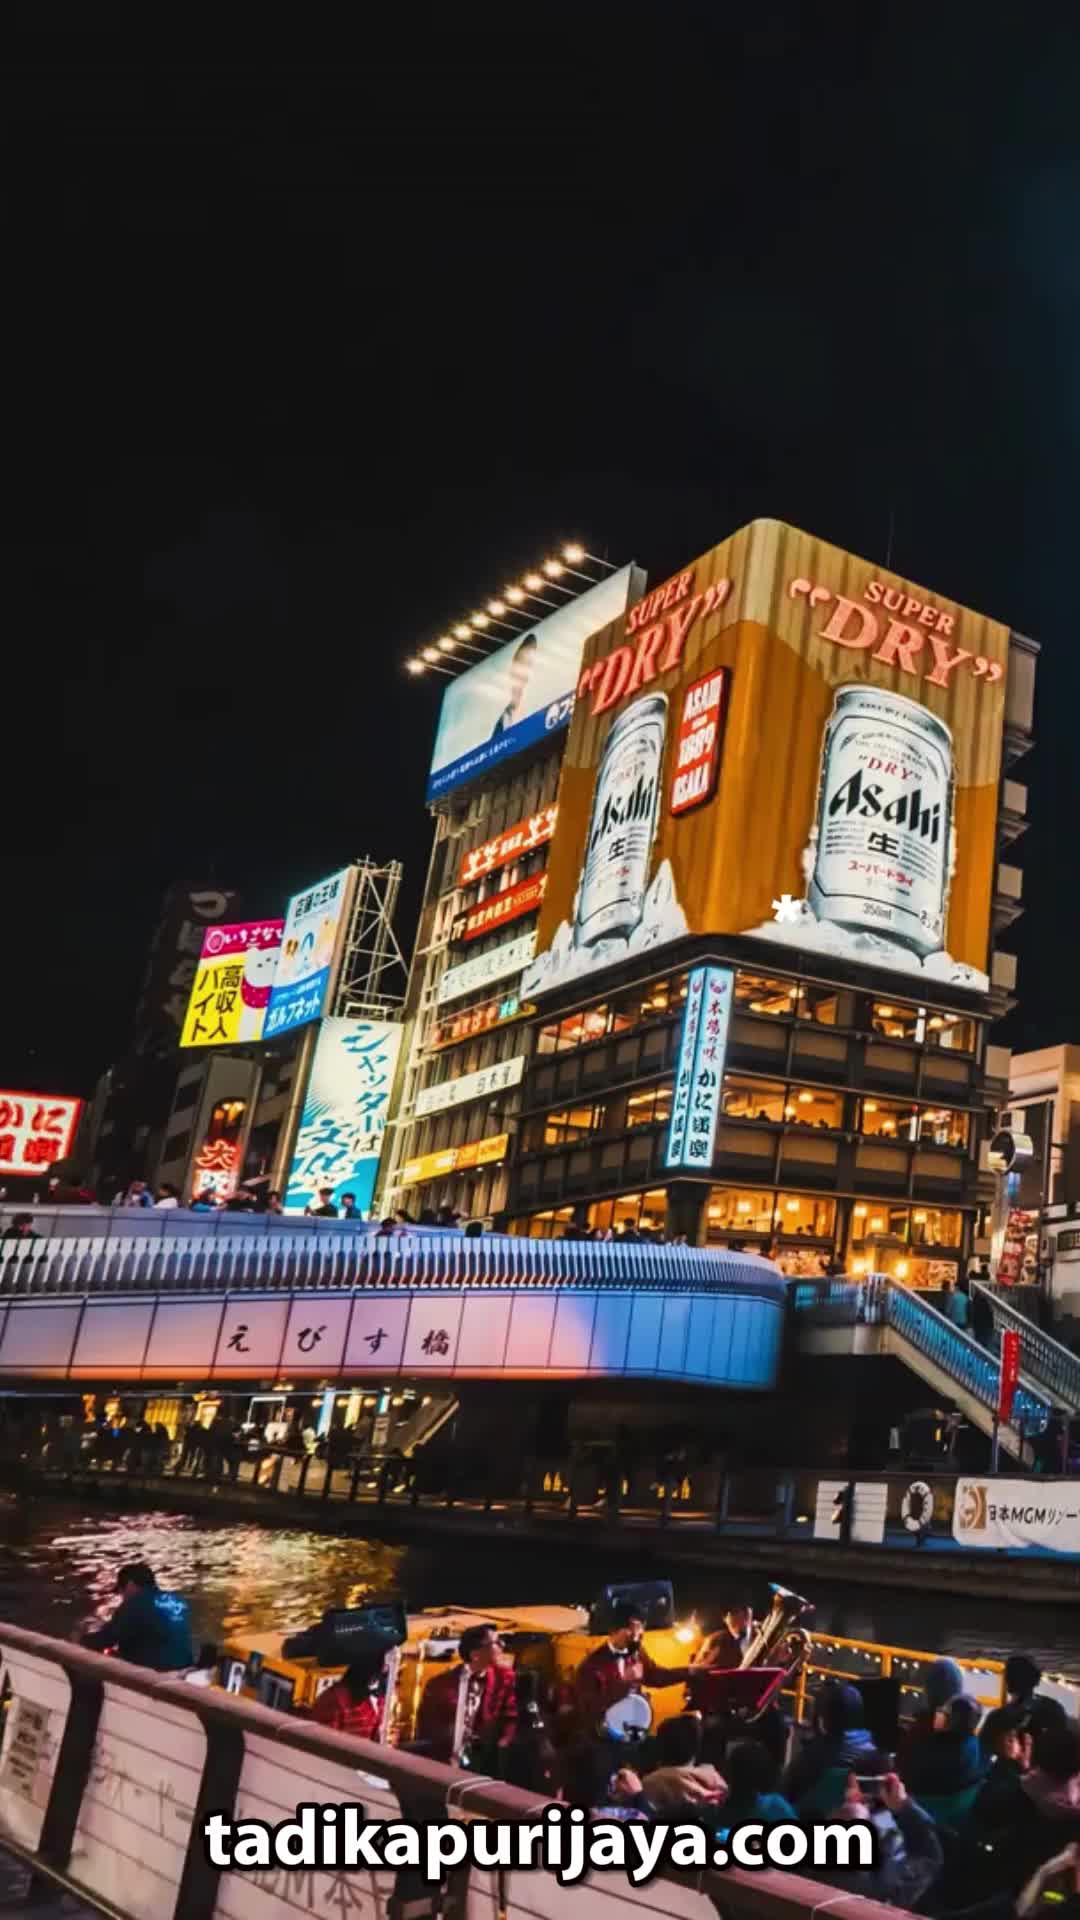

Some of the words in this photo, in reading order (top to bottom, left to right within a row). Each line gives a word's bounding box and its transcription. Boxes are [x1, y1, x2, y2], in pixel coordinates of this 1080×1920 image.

[626, 570, 695, 636] SUPER
[863, 580, 956, 636] SUPER
[591, 774, 655, 852] Asahi
[828, 768, 941, 845] Asahi
[608, 837, 627, 862] 生
[867, 831, 900, 859] 生
[227, 1325, 449, 1356] えびす橋
